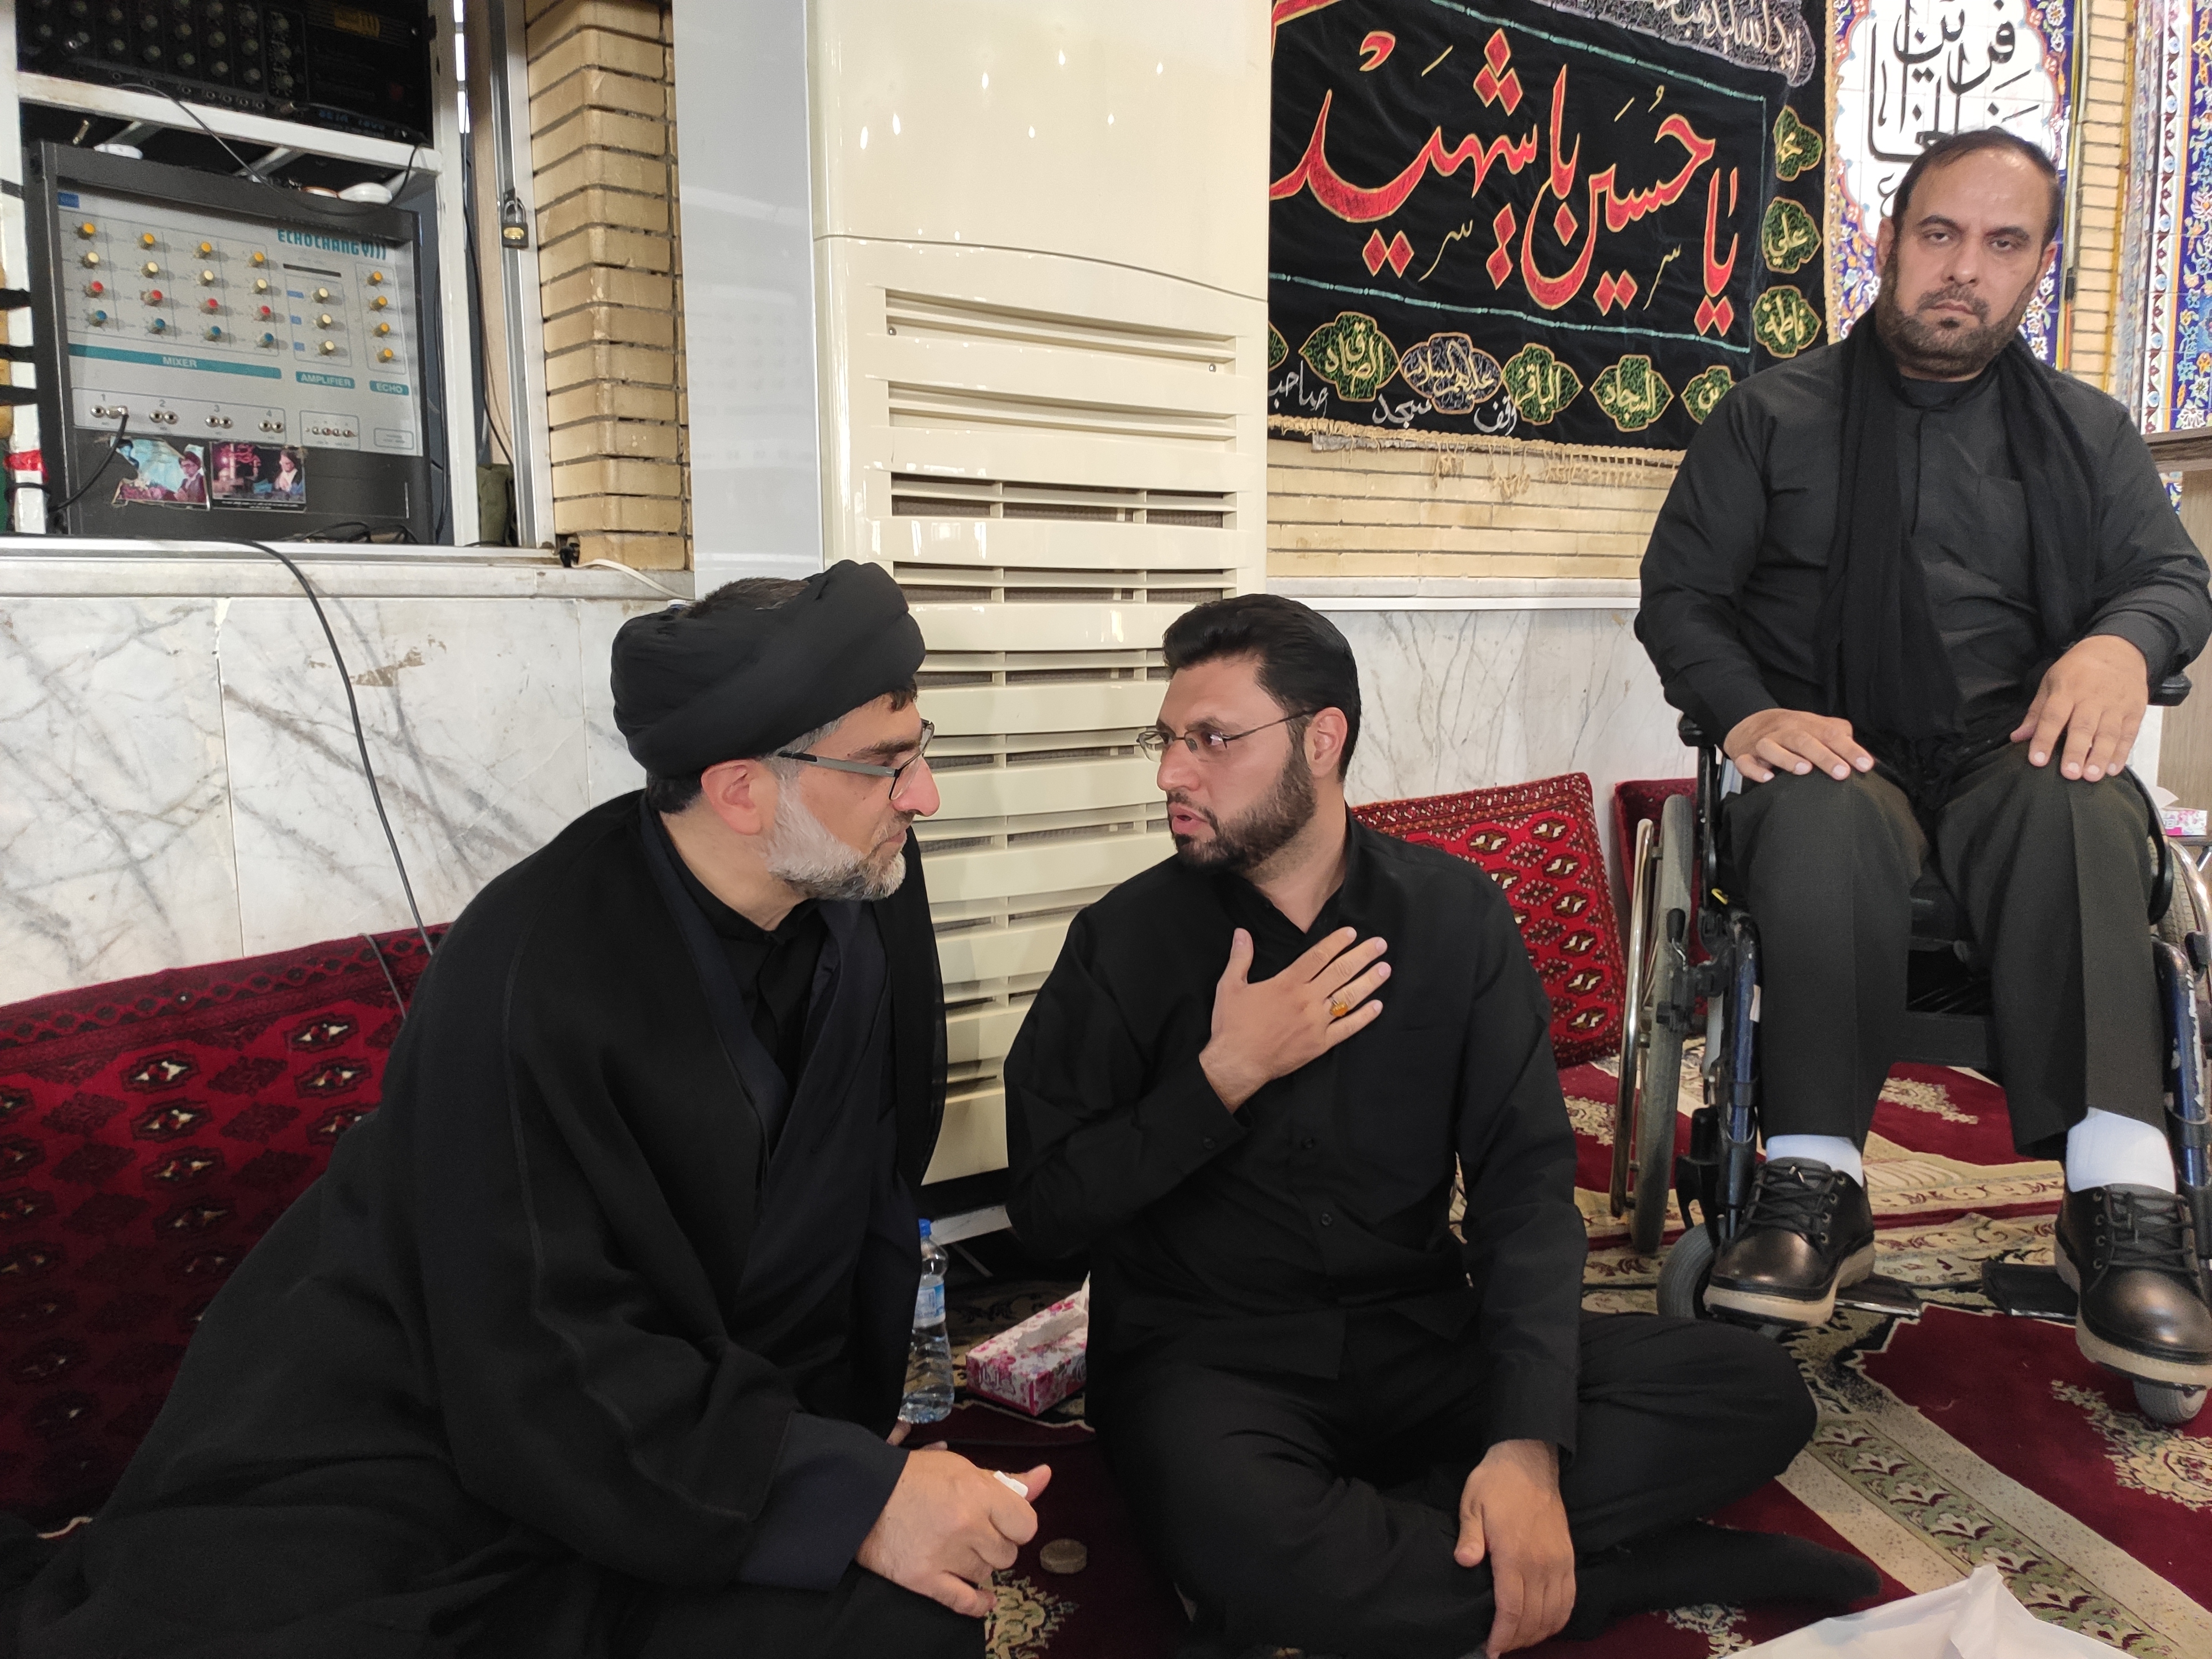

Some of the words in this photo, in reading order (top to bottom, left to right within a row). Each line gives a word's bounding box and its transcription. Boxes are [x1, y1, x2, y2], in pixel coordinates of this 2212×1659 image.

[163, 356, 198, 368] MIXER
[301, 373, 352, 388] AMPLIFIER
[376, 382, 404, 394] ECHO
[159, 399, 166, 408] 2
[213, 404, 220, 413] 3
[265, 409, 273, 418] 4
